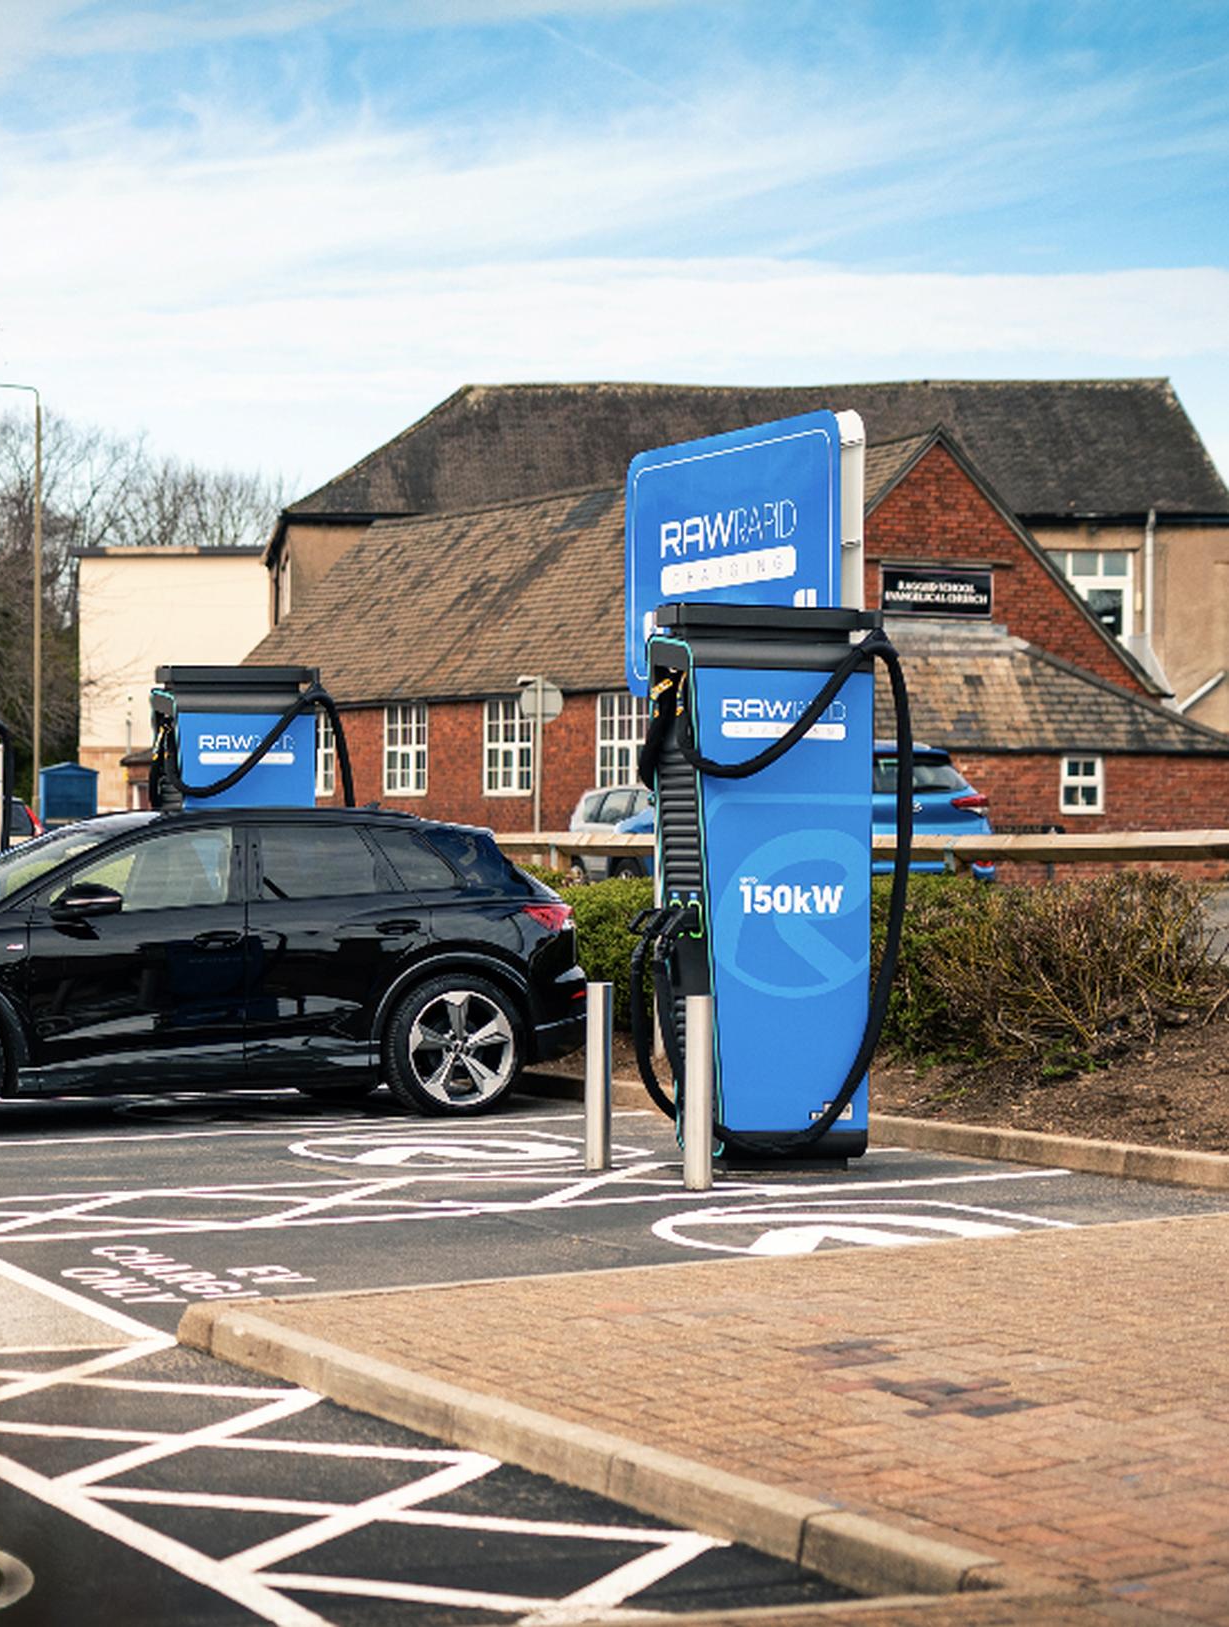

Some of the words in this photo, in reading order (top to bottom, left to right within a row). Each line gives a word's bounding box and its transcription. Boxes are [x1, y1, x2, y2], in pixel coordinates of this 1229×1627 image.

[739, 885, 844, 914] 150kW
[60, 1266, 188, 1304] ONLY
[91, 1245, 261, 1299] CHARGI
[226, 1265, 317, 1283] EV
